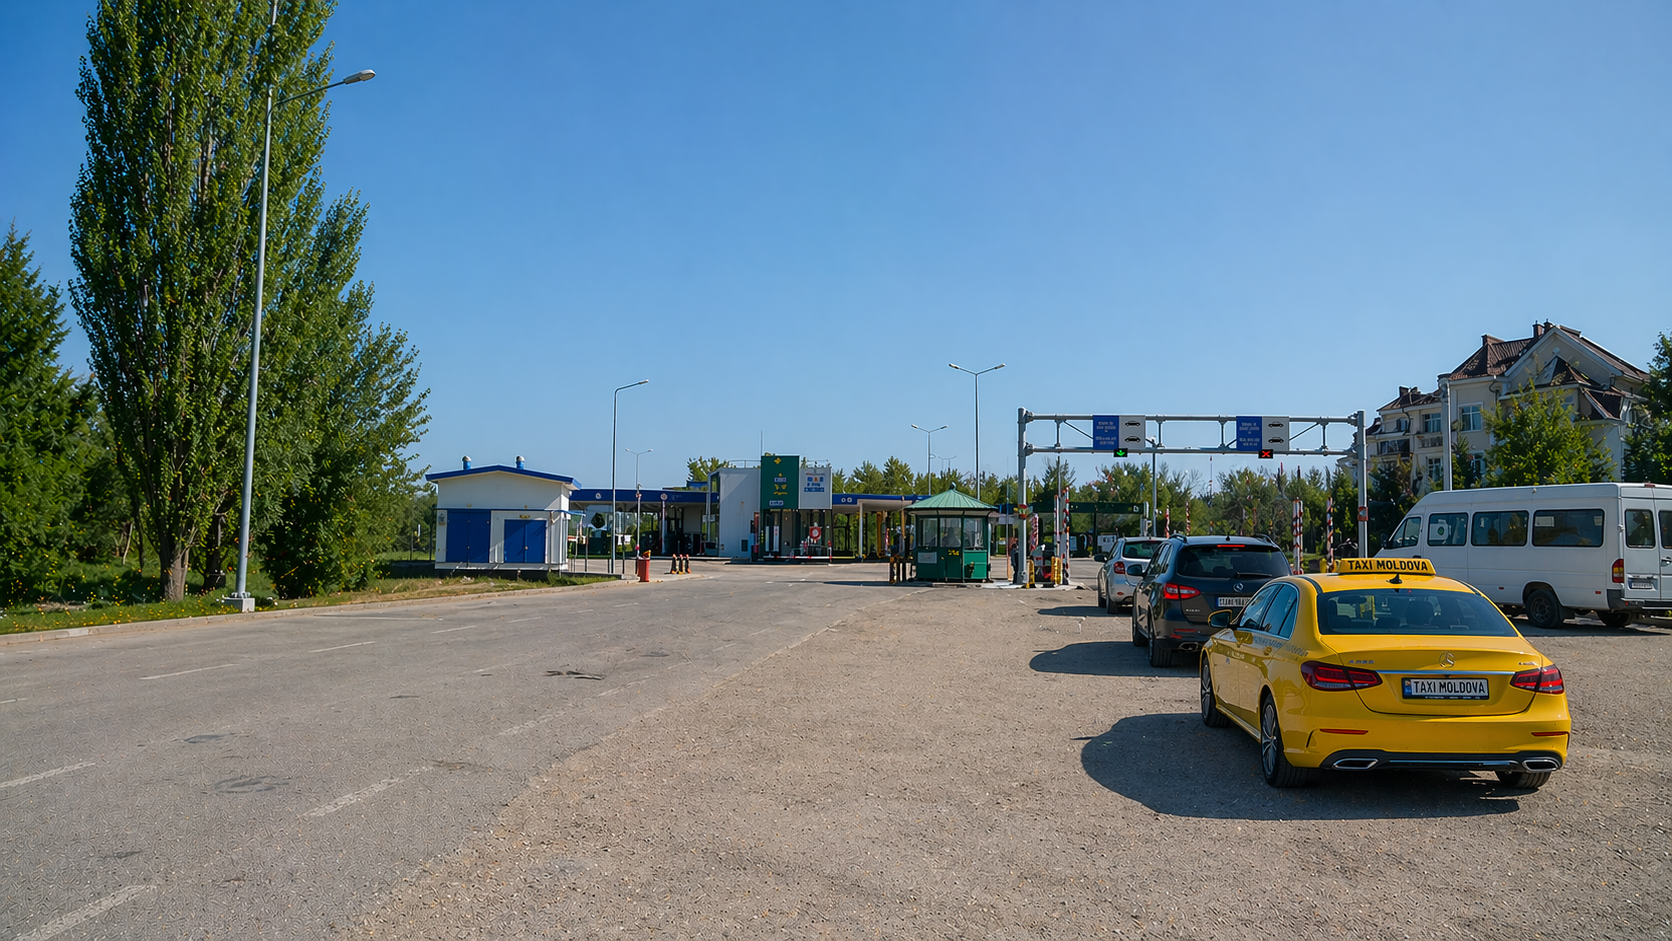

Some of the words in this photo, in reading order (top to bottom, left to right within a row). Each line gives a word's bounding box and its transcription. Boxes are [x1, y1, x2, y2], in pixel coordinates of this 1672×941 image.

[1347, 560, 1373, 570] TAXI
[1376, 560, 1428, 571] MOLDOVA
[1413, 681, 1436, 693] TAXI
[1439, 681, 1486, 694] MOLDOVA
